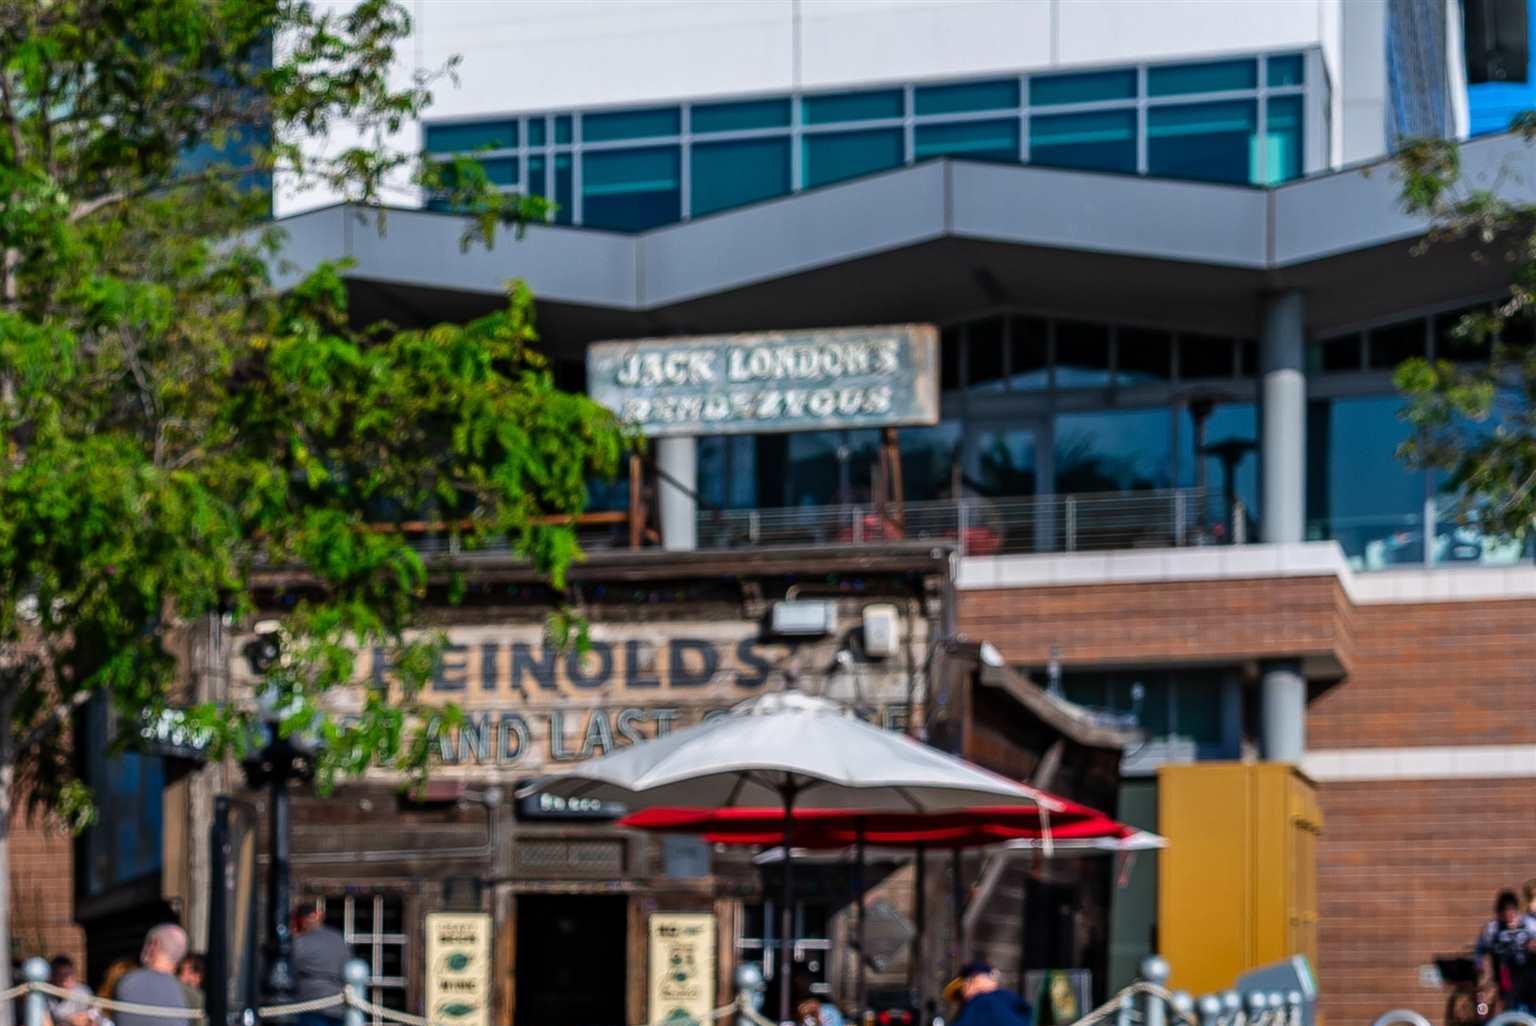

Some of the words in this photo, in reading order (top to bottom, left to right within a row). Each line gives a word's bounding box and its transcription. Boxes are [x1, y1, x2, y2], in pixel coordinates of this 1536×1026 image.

[616, 351, 716, 386] JACK
[426, 708, 531, 767] AND
[550, 704, 678, 761] LAST
